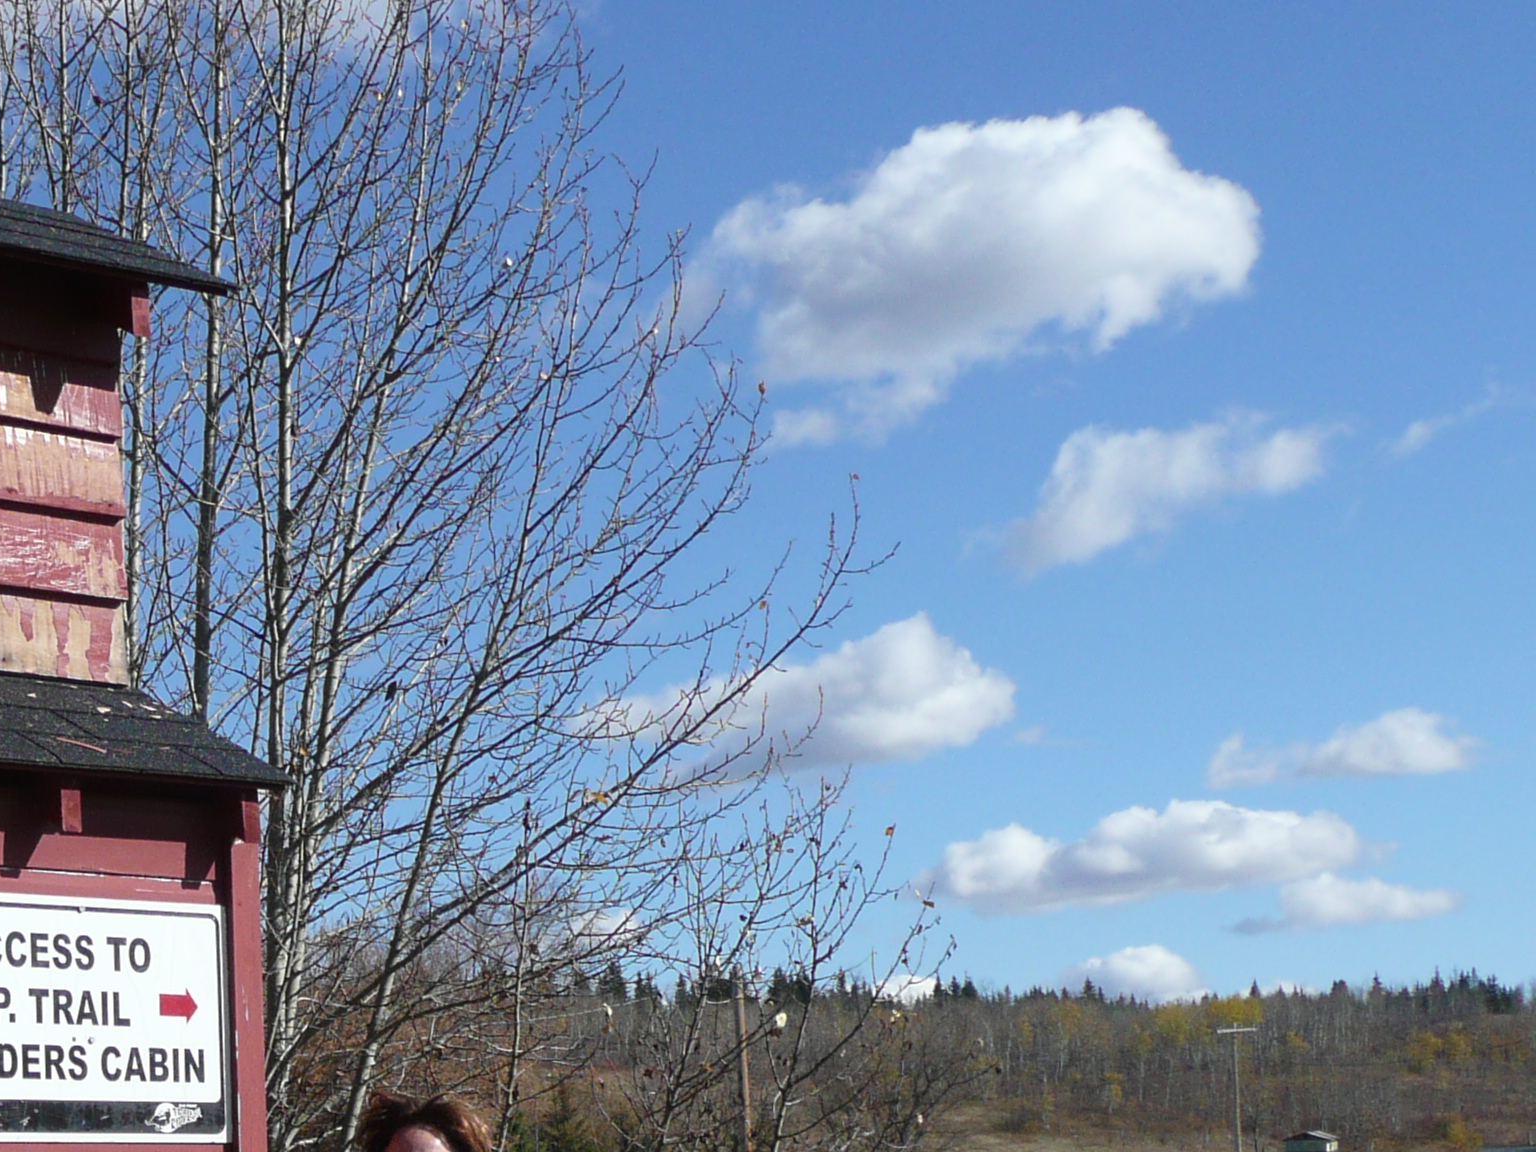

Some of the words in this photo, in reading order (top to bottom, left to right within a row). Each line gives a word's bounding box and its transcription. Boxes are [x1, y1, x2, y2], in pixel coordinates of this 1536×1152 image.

[106, 936, 152, 973] TO
[28, 988, 131, 1027] TRAIL
[100, 1046, 206, 1084] CABIN
